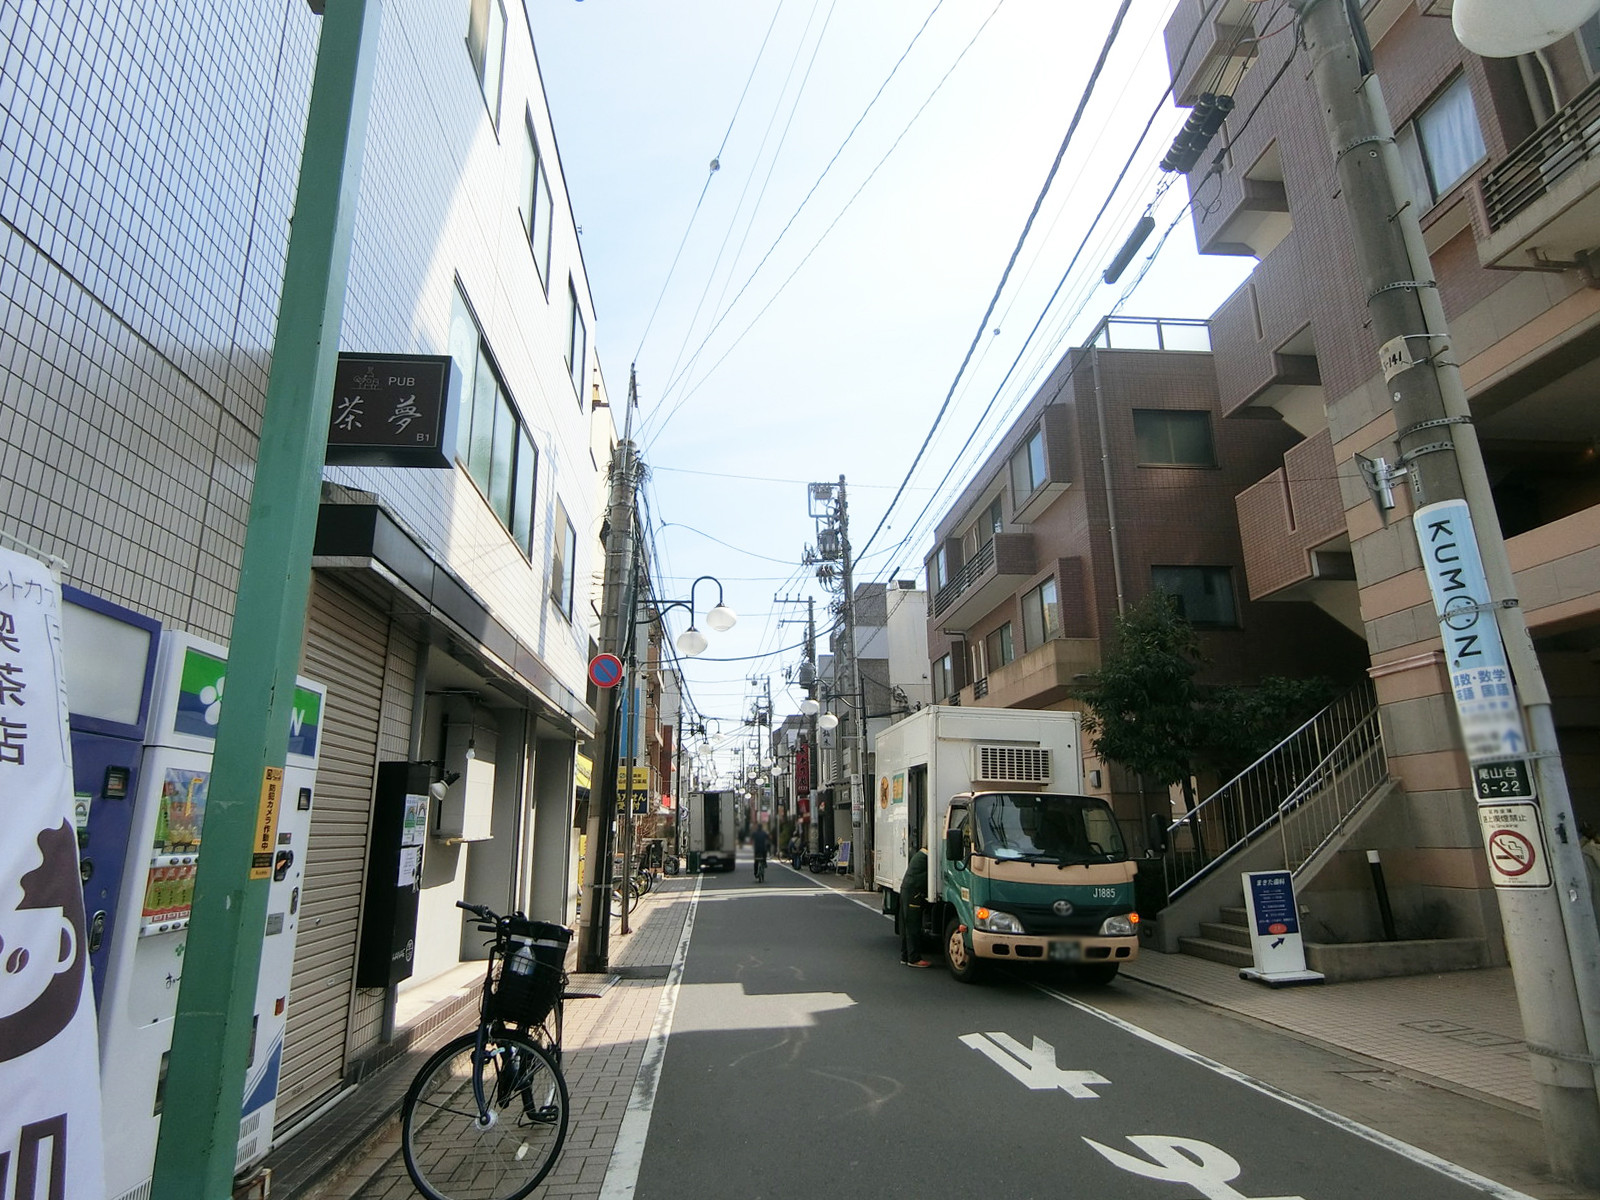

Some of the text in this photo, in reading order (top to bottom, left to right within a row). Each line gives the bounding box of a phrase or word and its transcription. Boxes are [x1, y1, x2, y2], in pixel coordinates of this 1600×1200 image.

[388, 376, 415, 387] PUB
[416, 433, 430, 442] B1
[1427, 519, 1483, 658] KUMON
[1478, 766, 1518, 780] 尾山台
[1481, 780, 1521, 794] 3-22
[261, 783, 277, 851] 防犯カメラ作動中
[1092, 887, 1116, 899] J1885
